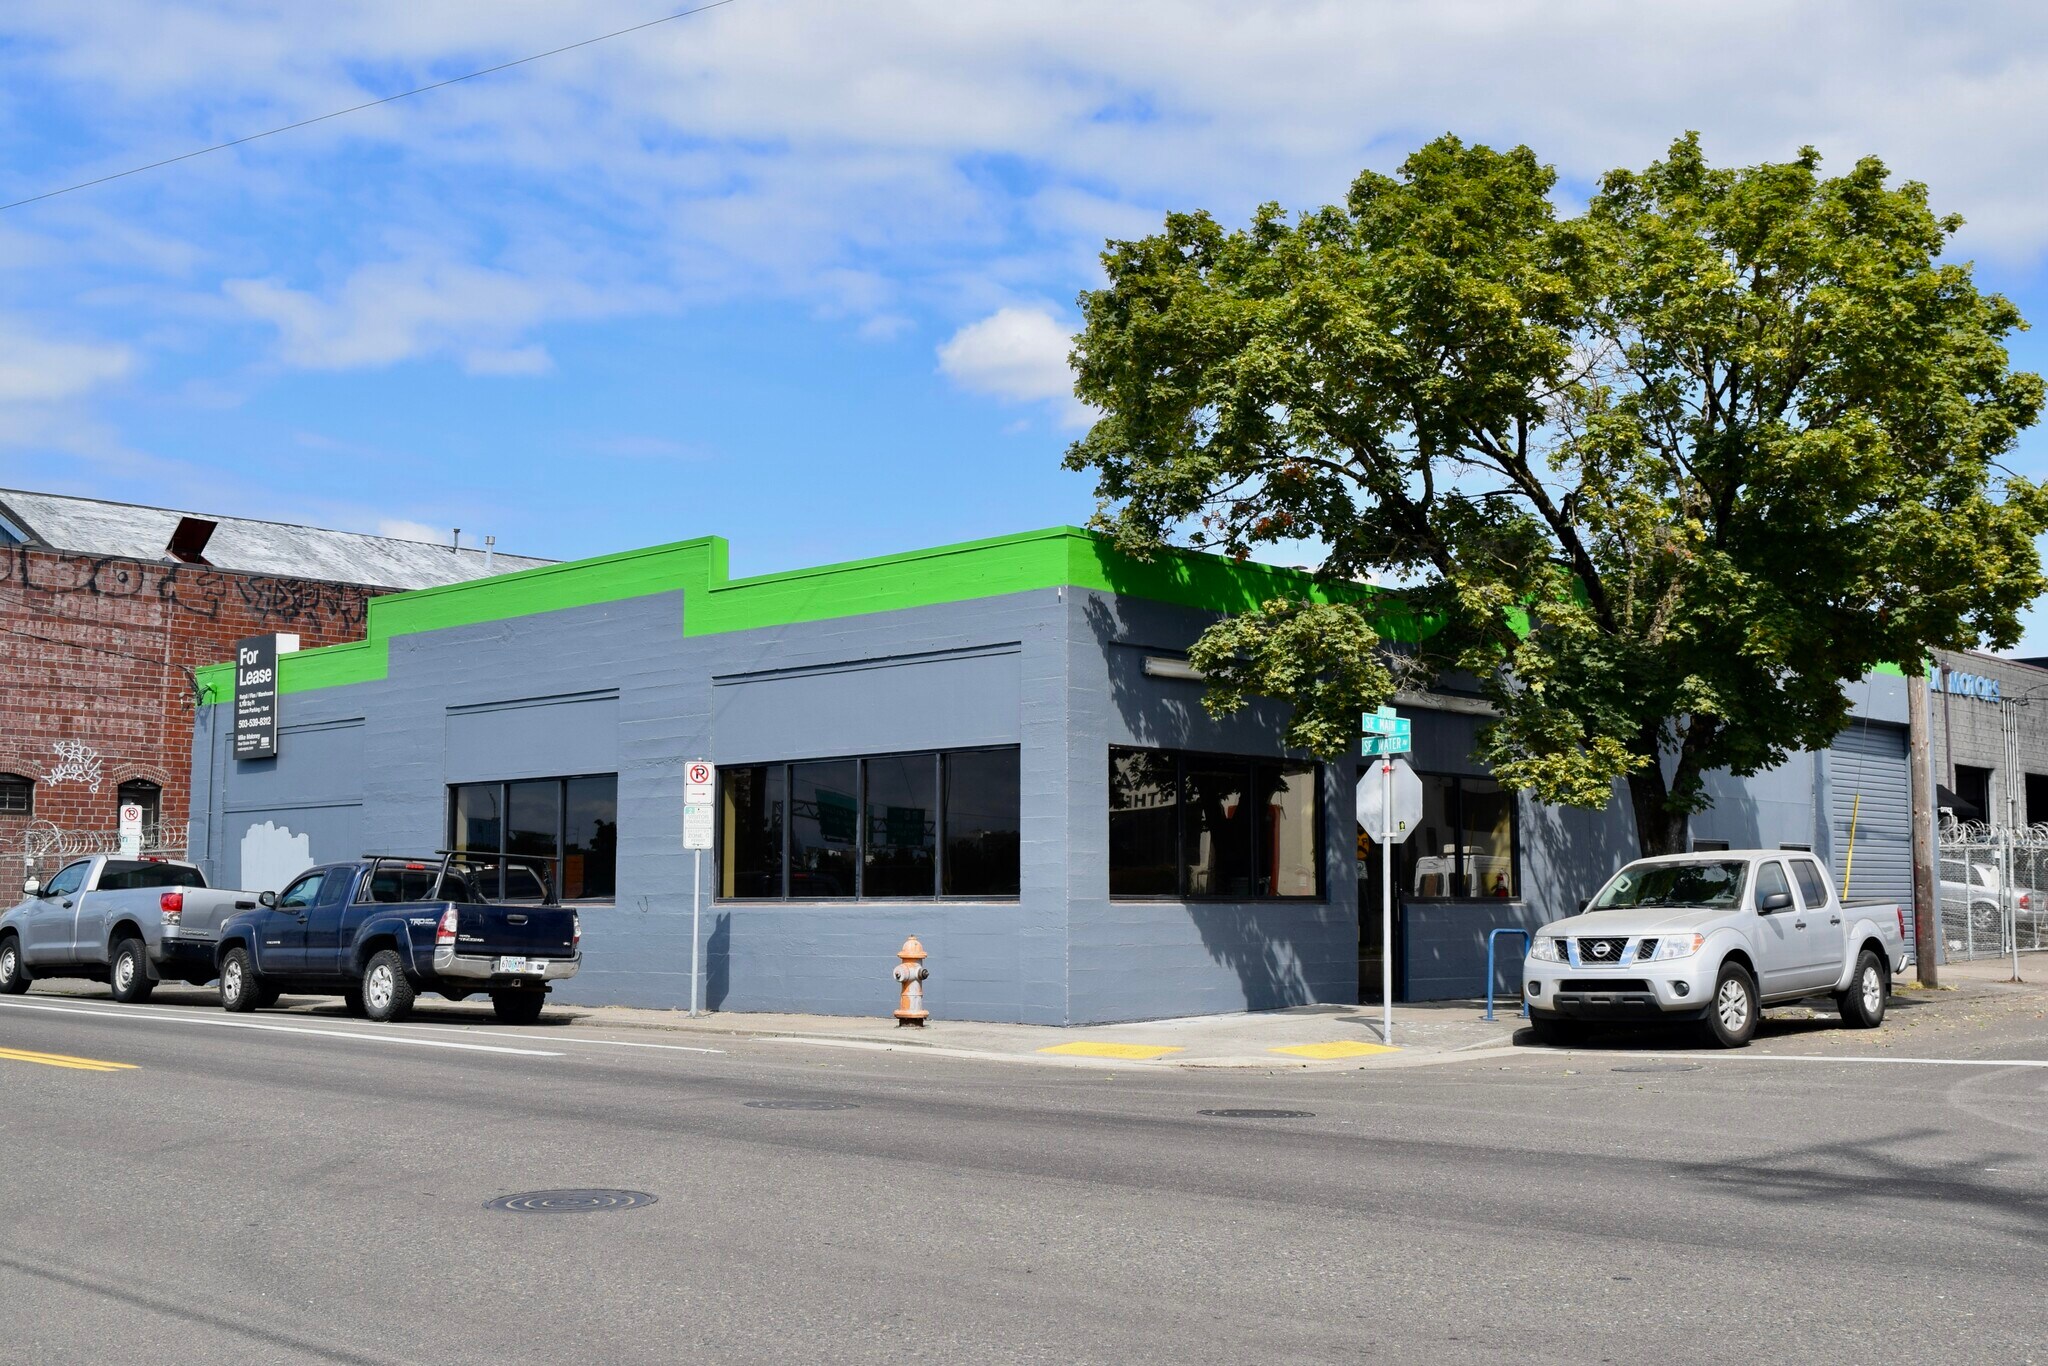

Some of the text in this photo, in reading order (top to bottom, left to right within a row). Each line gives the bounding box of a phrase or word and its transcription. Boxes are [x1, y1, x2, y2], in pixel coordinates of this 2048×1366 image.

[240, 648, 259, 666] For
[239, 668, 272, 686] Lease
[1948, 671, 2001, 703] MOTORS
[1365, 717, 1374, 729] SE
[1380, 718, 1395, 732] MAIN
[1364, 740, 1374, 753] SE
[1378, 737, 1402, 750] WATER
